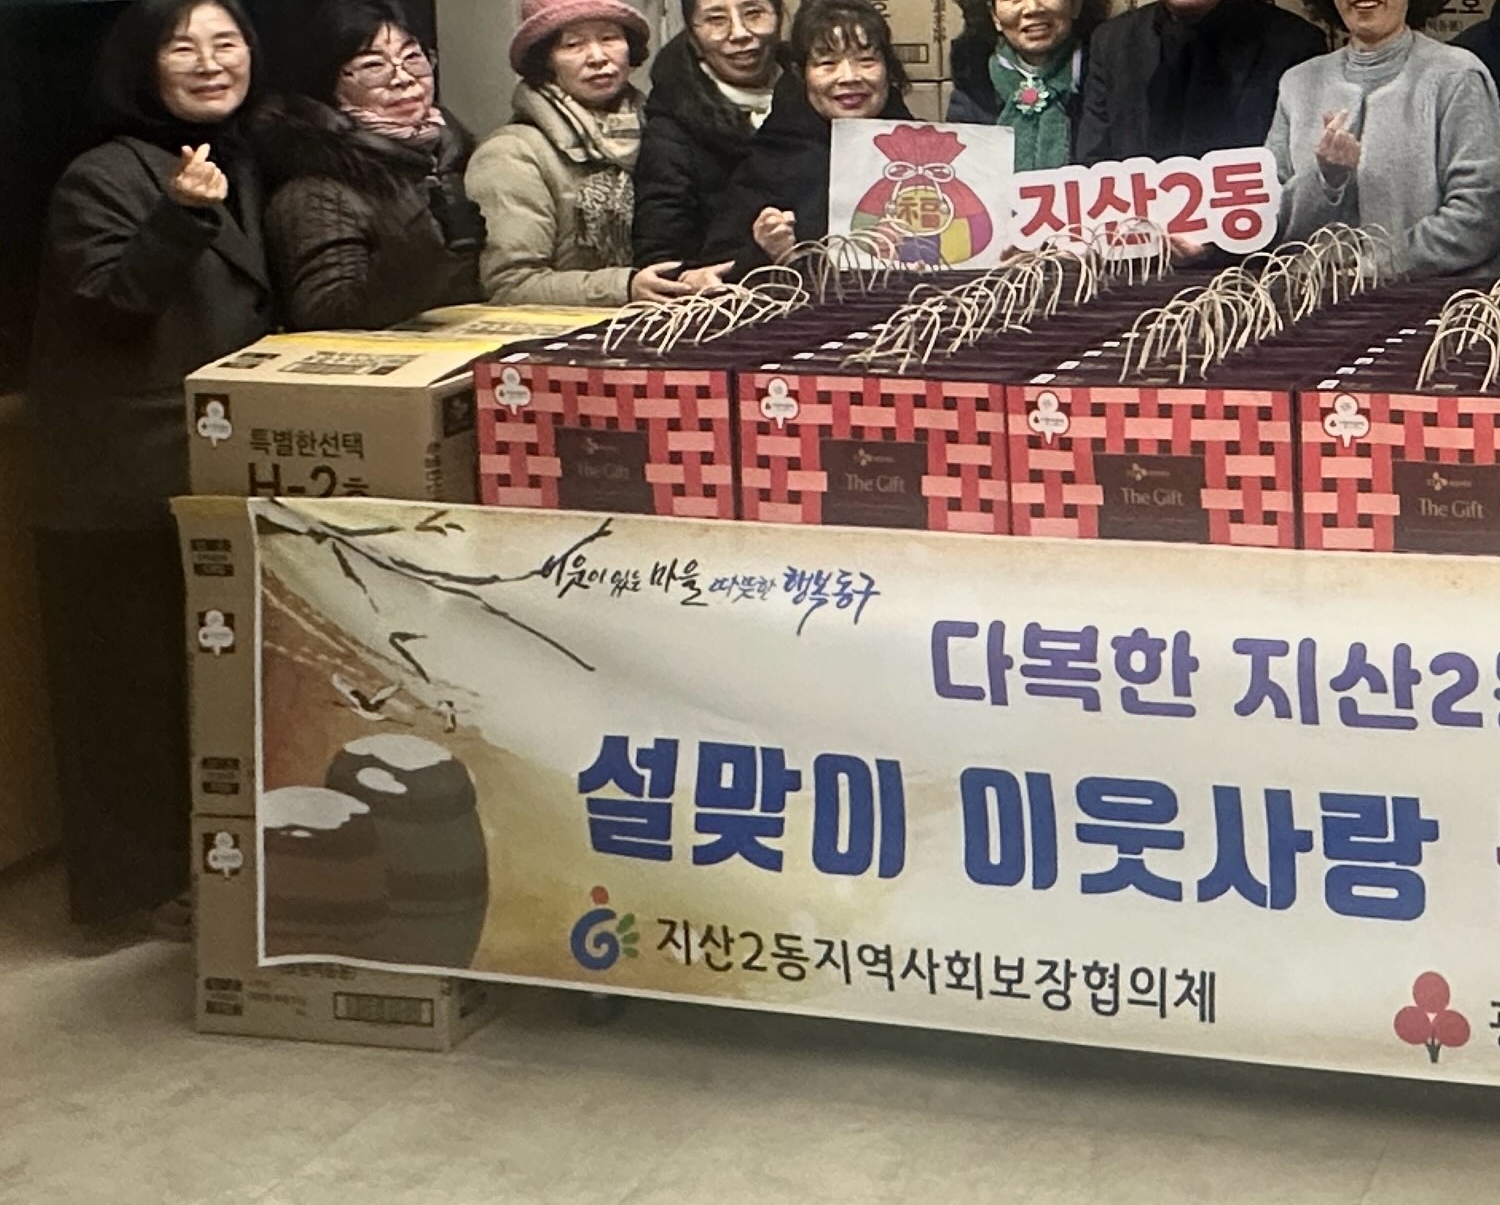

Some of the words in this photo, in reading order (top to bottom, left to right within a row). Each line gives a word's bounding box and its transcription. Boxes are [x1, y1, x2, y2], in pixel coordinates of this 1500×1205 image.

[1017, 161, 1271, 246] 지산2동
[250, 428, 365, 460] 특별한선택
[844, 473, 873, 493] The
[875, 475, 906, 494] Gift
[1121, 487, 1151, 506] The
[1153, 488, 1184, 507] Gift
[1419, 497, 1449, 517] The
[1451, 499, 1484, 520] Gift
[609, 567, 642, 599] 있는
[650, 557, 708, 607] 마을
[708, 572, 778, 603] 따뜻한
[782, 564, 881, 636] 행복동구
[931, 619, 1200, 719] 다복한
[577, 733, 907, 881] 설맞이
[960, 765, 1441, 922] 이웃사랑
[655, 917, 1217, 1024] 지산2동지역사회보장협의체
